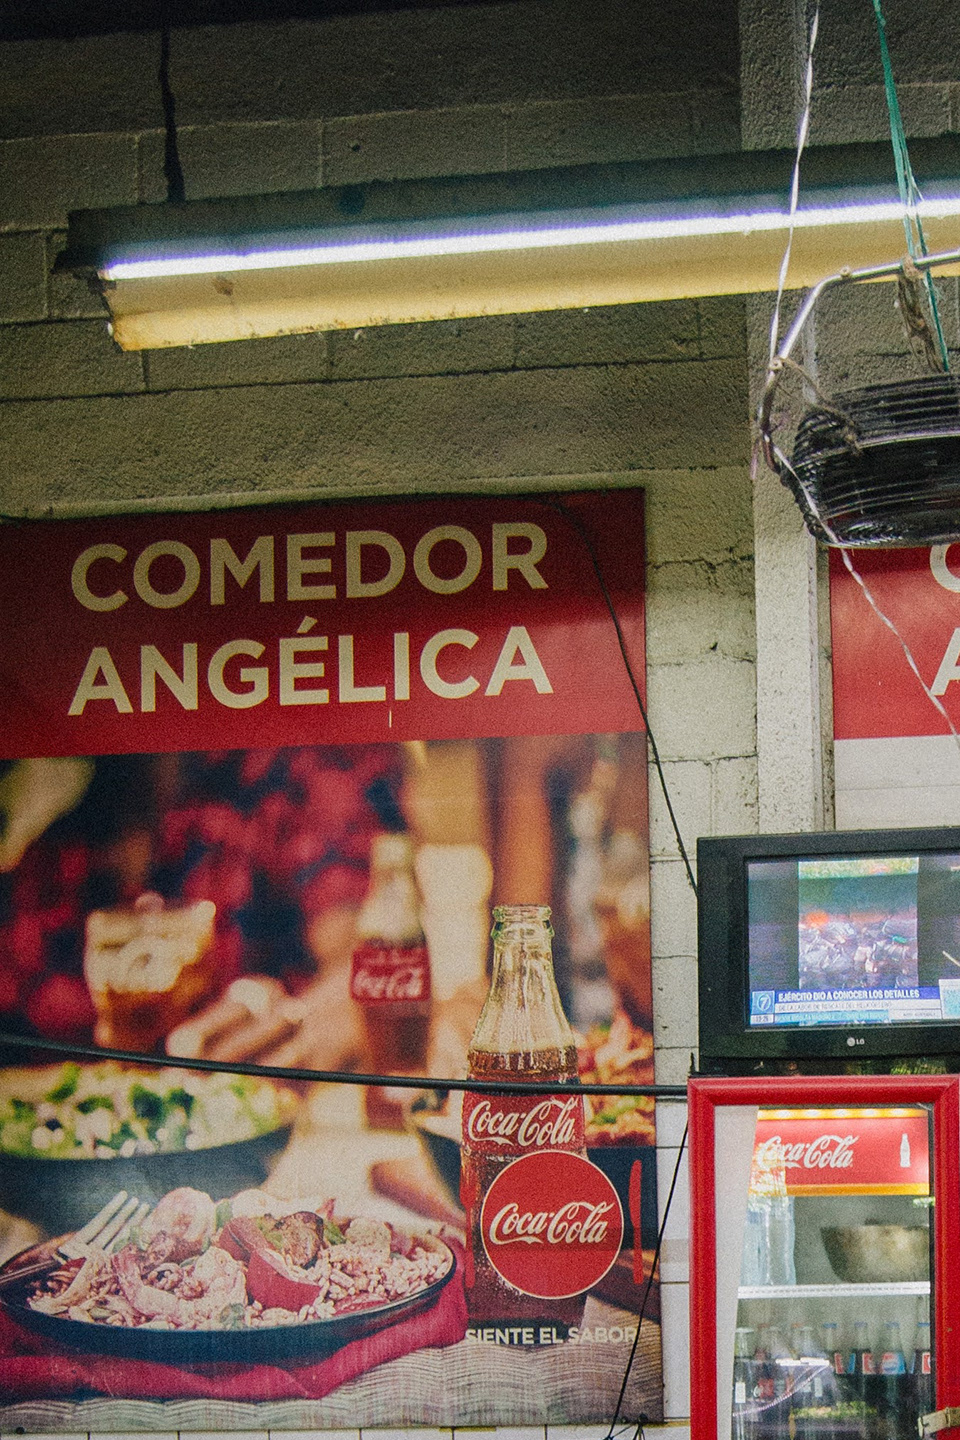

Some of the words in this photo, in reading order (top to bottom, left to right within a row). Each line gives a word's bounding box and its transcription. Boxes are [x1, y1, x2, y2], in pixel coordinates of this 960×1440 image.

[70, 522, 548, 612] COMEDOR
[67, 616, 554, 716] ANGÉLICA
[869, 989, 883, 999] LOS
[884, 989, 919, 999] DETALLES
[468, 1097, 578, 1147] Coca-Cola
[757, 1134, 859, 1168] Coca-Cola
[489, 1201, 614, 1245] Coca-Cola
[466, 1329, 534, 1345] SIENTE
[540, 1327, 563, 1344] EL
[568, 1326, 638, 1343] SABOR
